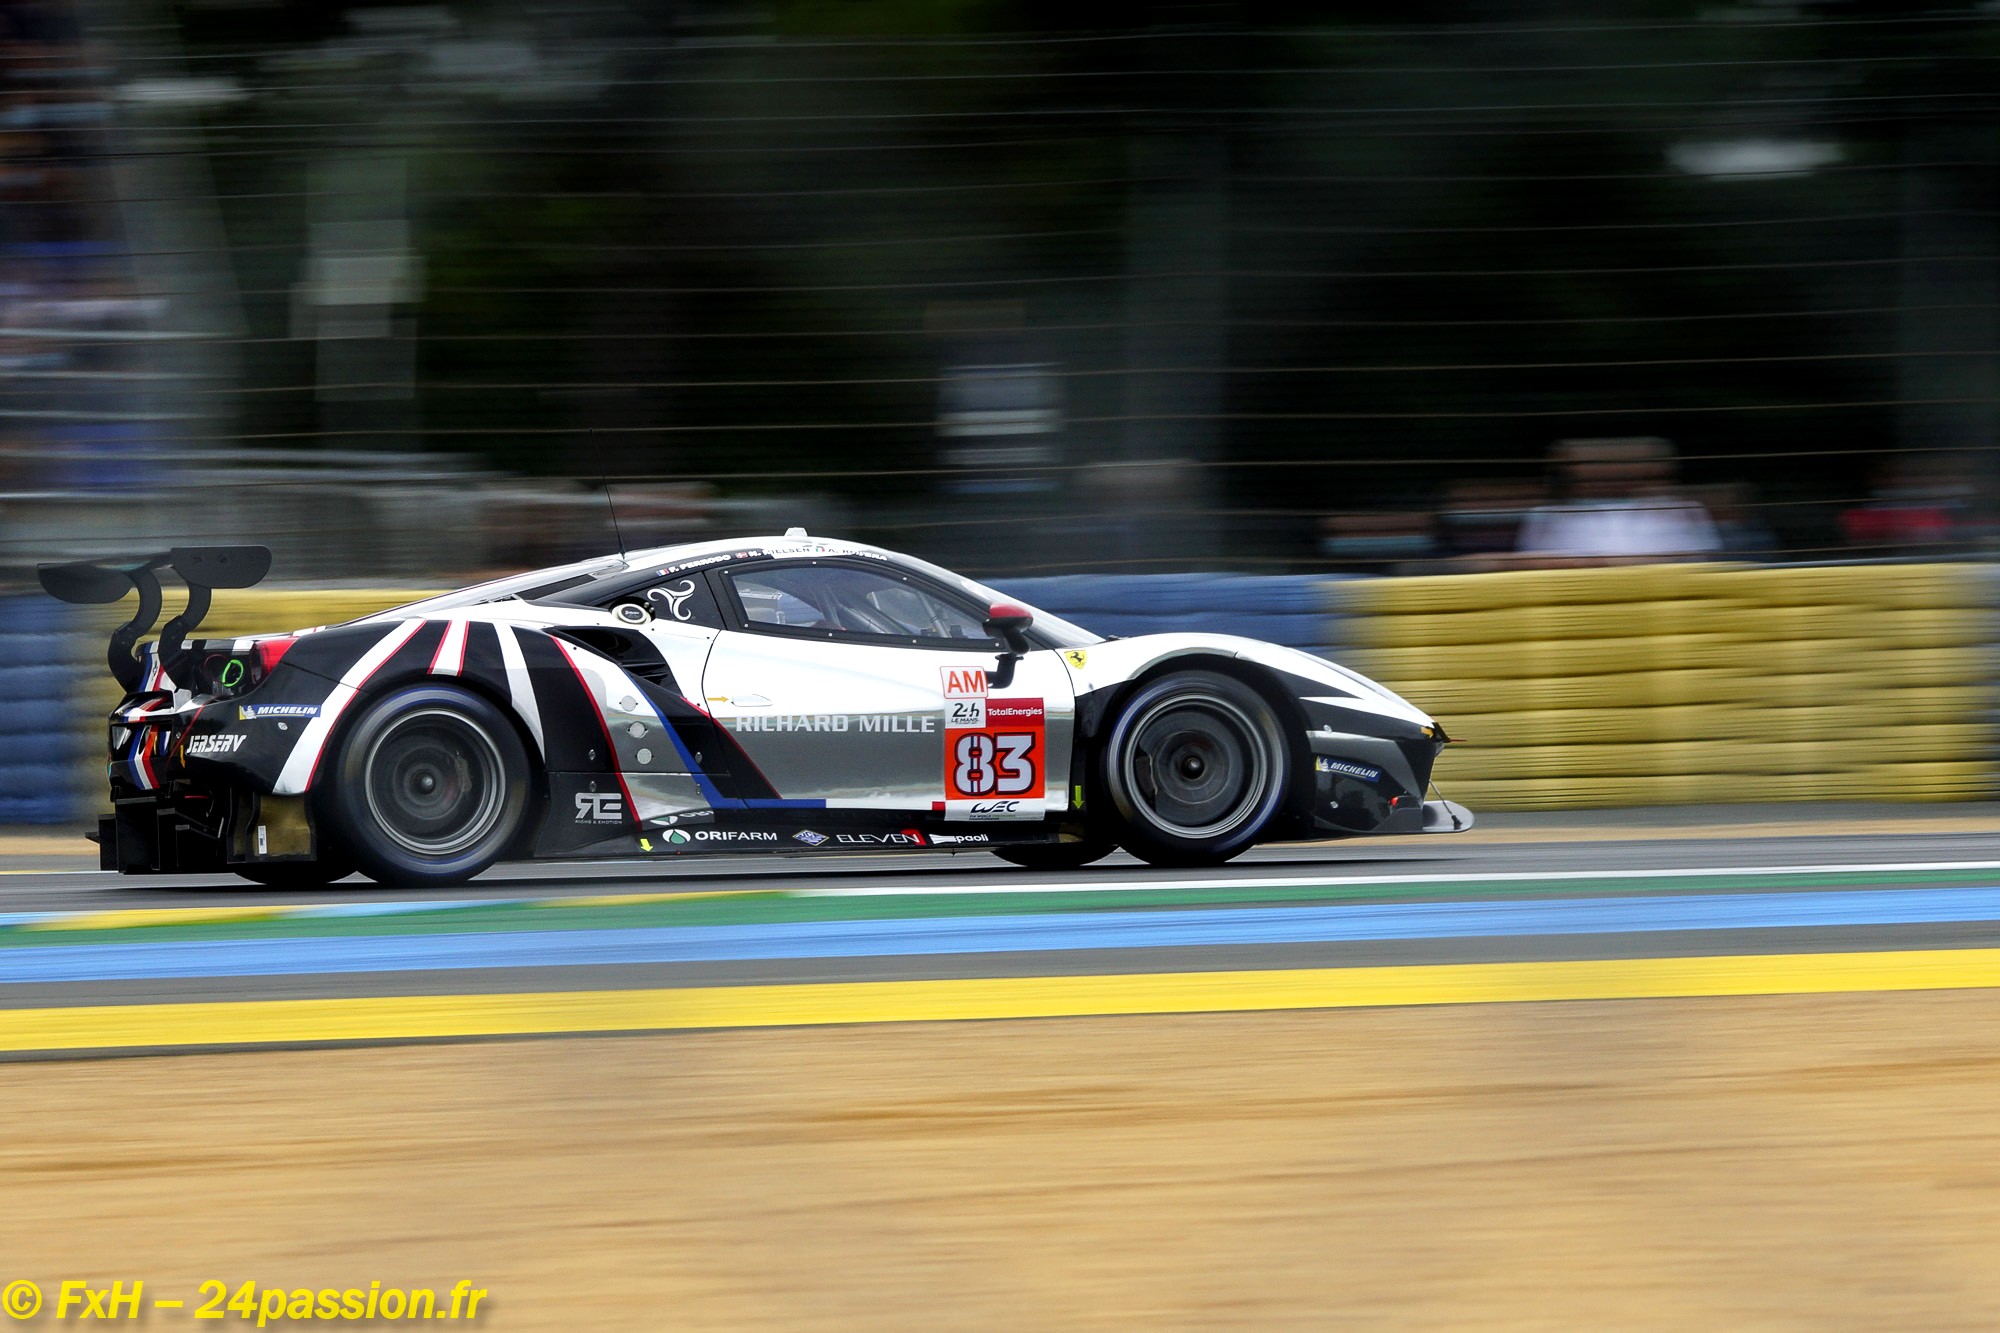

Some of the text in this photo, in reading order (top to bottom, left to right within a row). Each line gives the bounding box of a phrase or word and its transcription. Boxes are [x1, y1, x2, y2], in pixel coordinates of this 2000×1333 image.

[680, 554, 731, 570] PERRODO
[947, 670, 985, 693] AM
[257, 706, 318, 715] MICHELIN
[987, 707, 1043, 717] TotalEnergies
[735, 715, 936, 733] RICHARD MILLE
[186, 734, 247, 754] JERSERV
[953, 732, 1036, 796] 83
[1330, 762, 1379, 778] MICHELIN
[970, 801, 1020, 813] WEC
[694, 830, 778, 841] ORIFARM
[836, 833, 921, 843] ELEVEN
[955, 834, 989, 844] paoli
